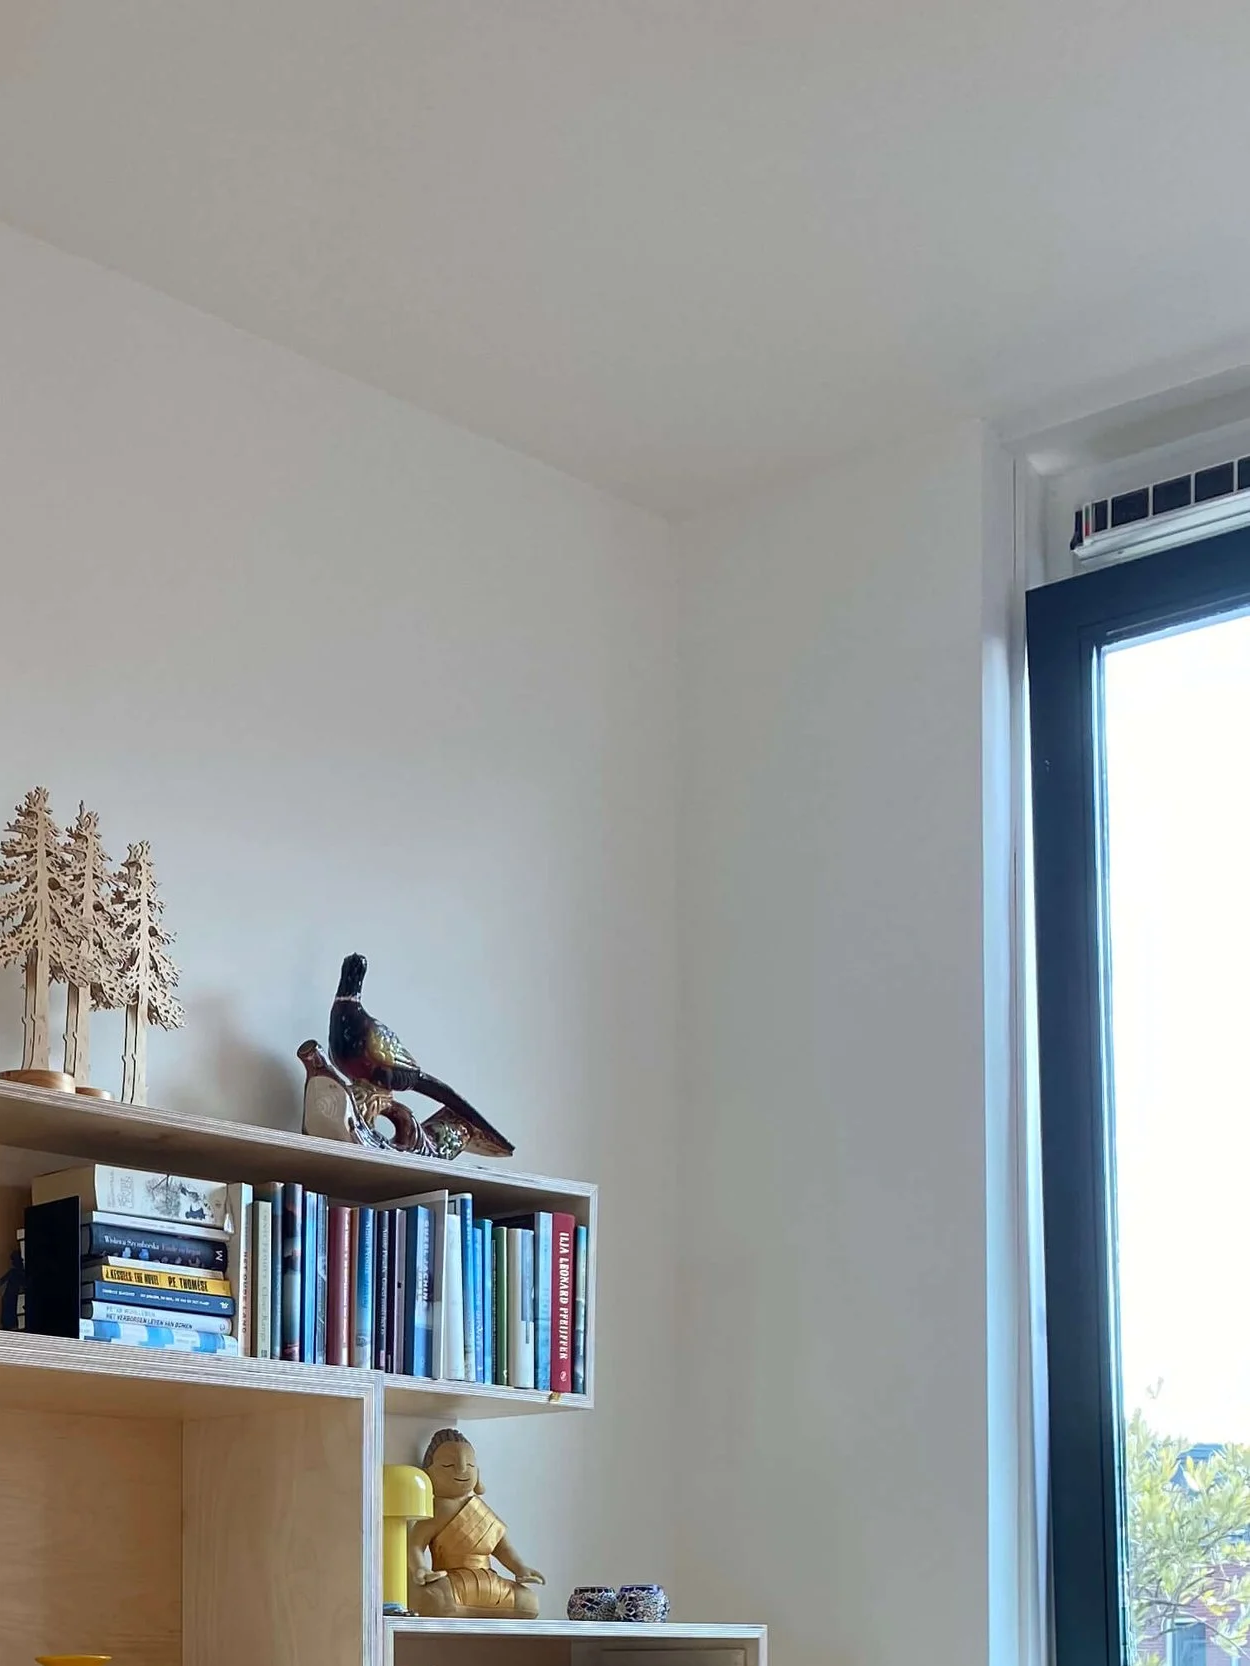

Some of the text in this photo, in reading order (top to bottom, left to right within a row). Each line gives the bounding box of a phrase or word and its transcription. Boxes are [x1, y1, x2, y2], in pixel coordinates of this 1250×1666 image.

[135, 1271, 143, 1283] THE
[559, 1232, 569, 1360] ILJA LEONARD PFEIJFFER
